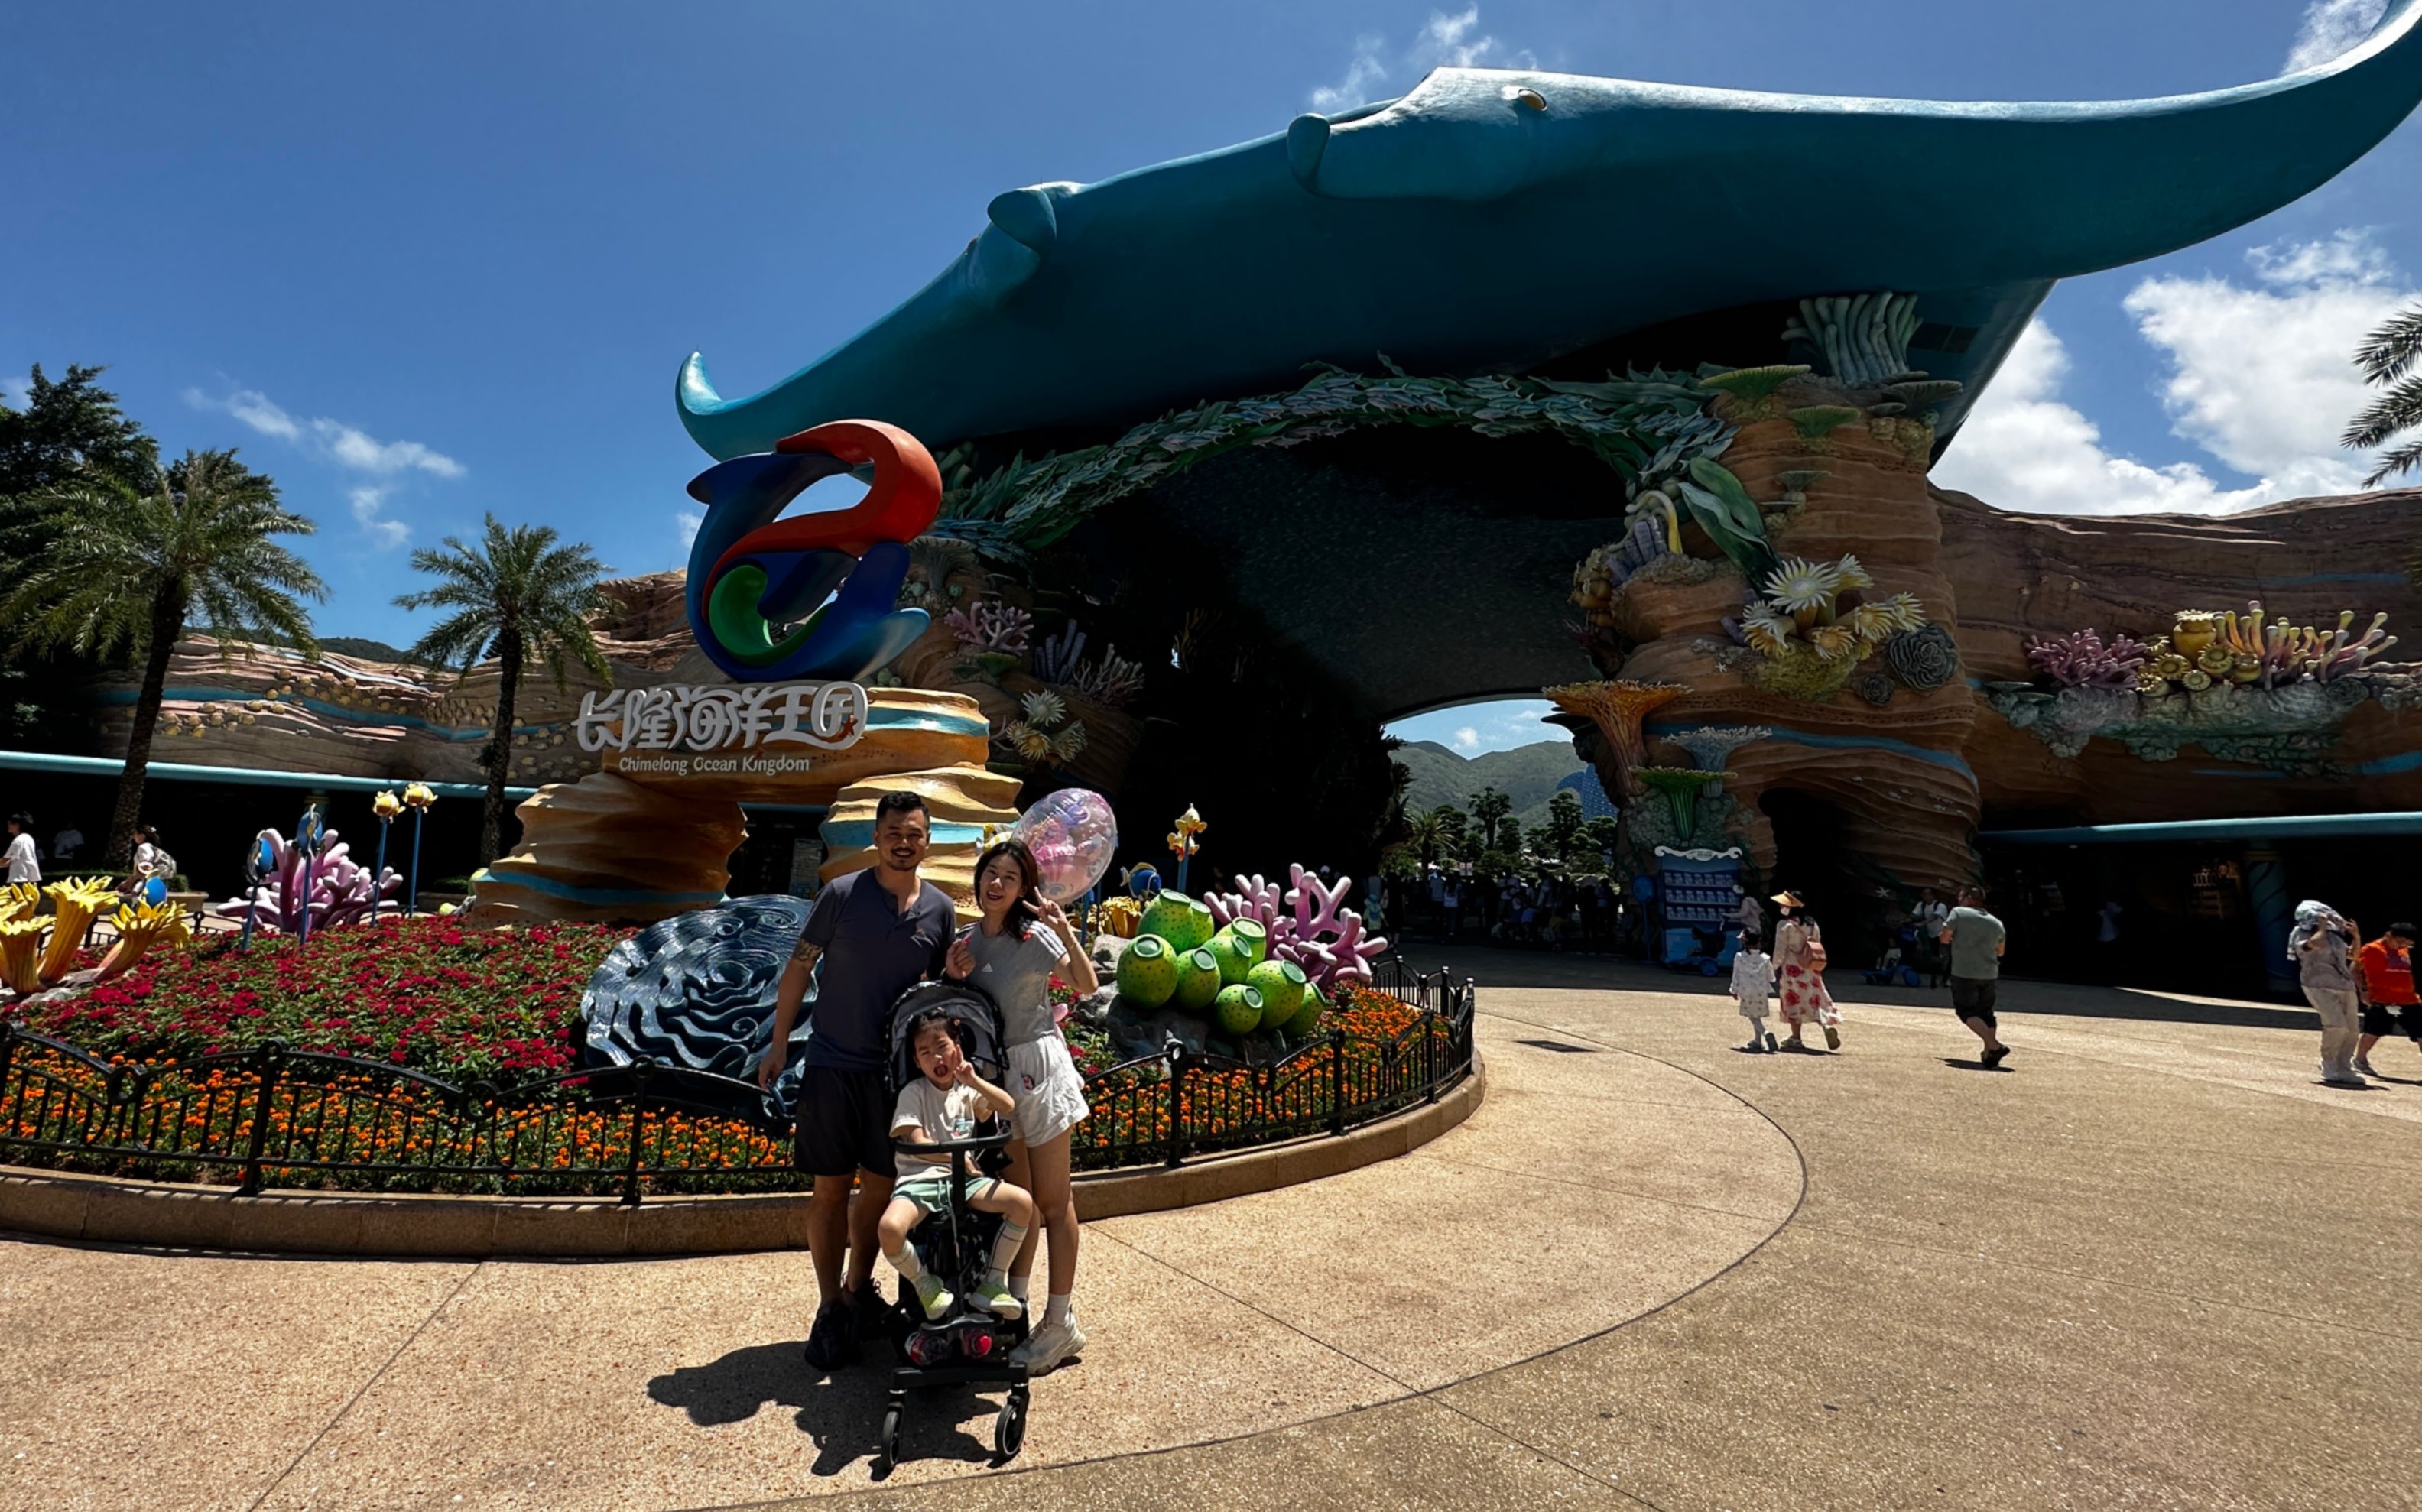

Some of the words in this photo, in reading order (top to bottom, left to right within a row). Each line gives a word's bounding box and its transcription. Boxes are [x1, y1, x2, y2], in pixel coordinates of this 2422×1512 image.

[572, 681, 868, 752] 长隆海洋王国
[619, 756, 688, 776] Chimelong
[693, 757, 737, 771] Ocean
[742, 754, 810, 776] Kingdom
